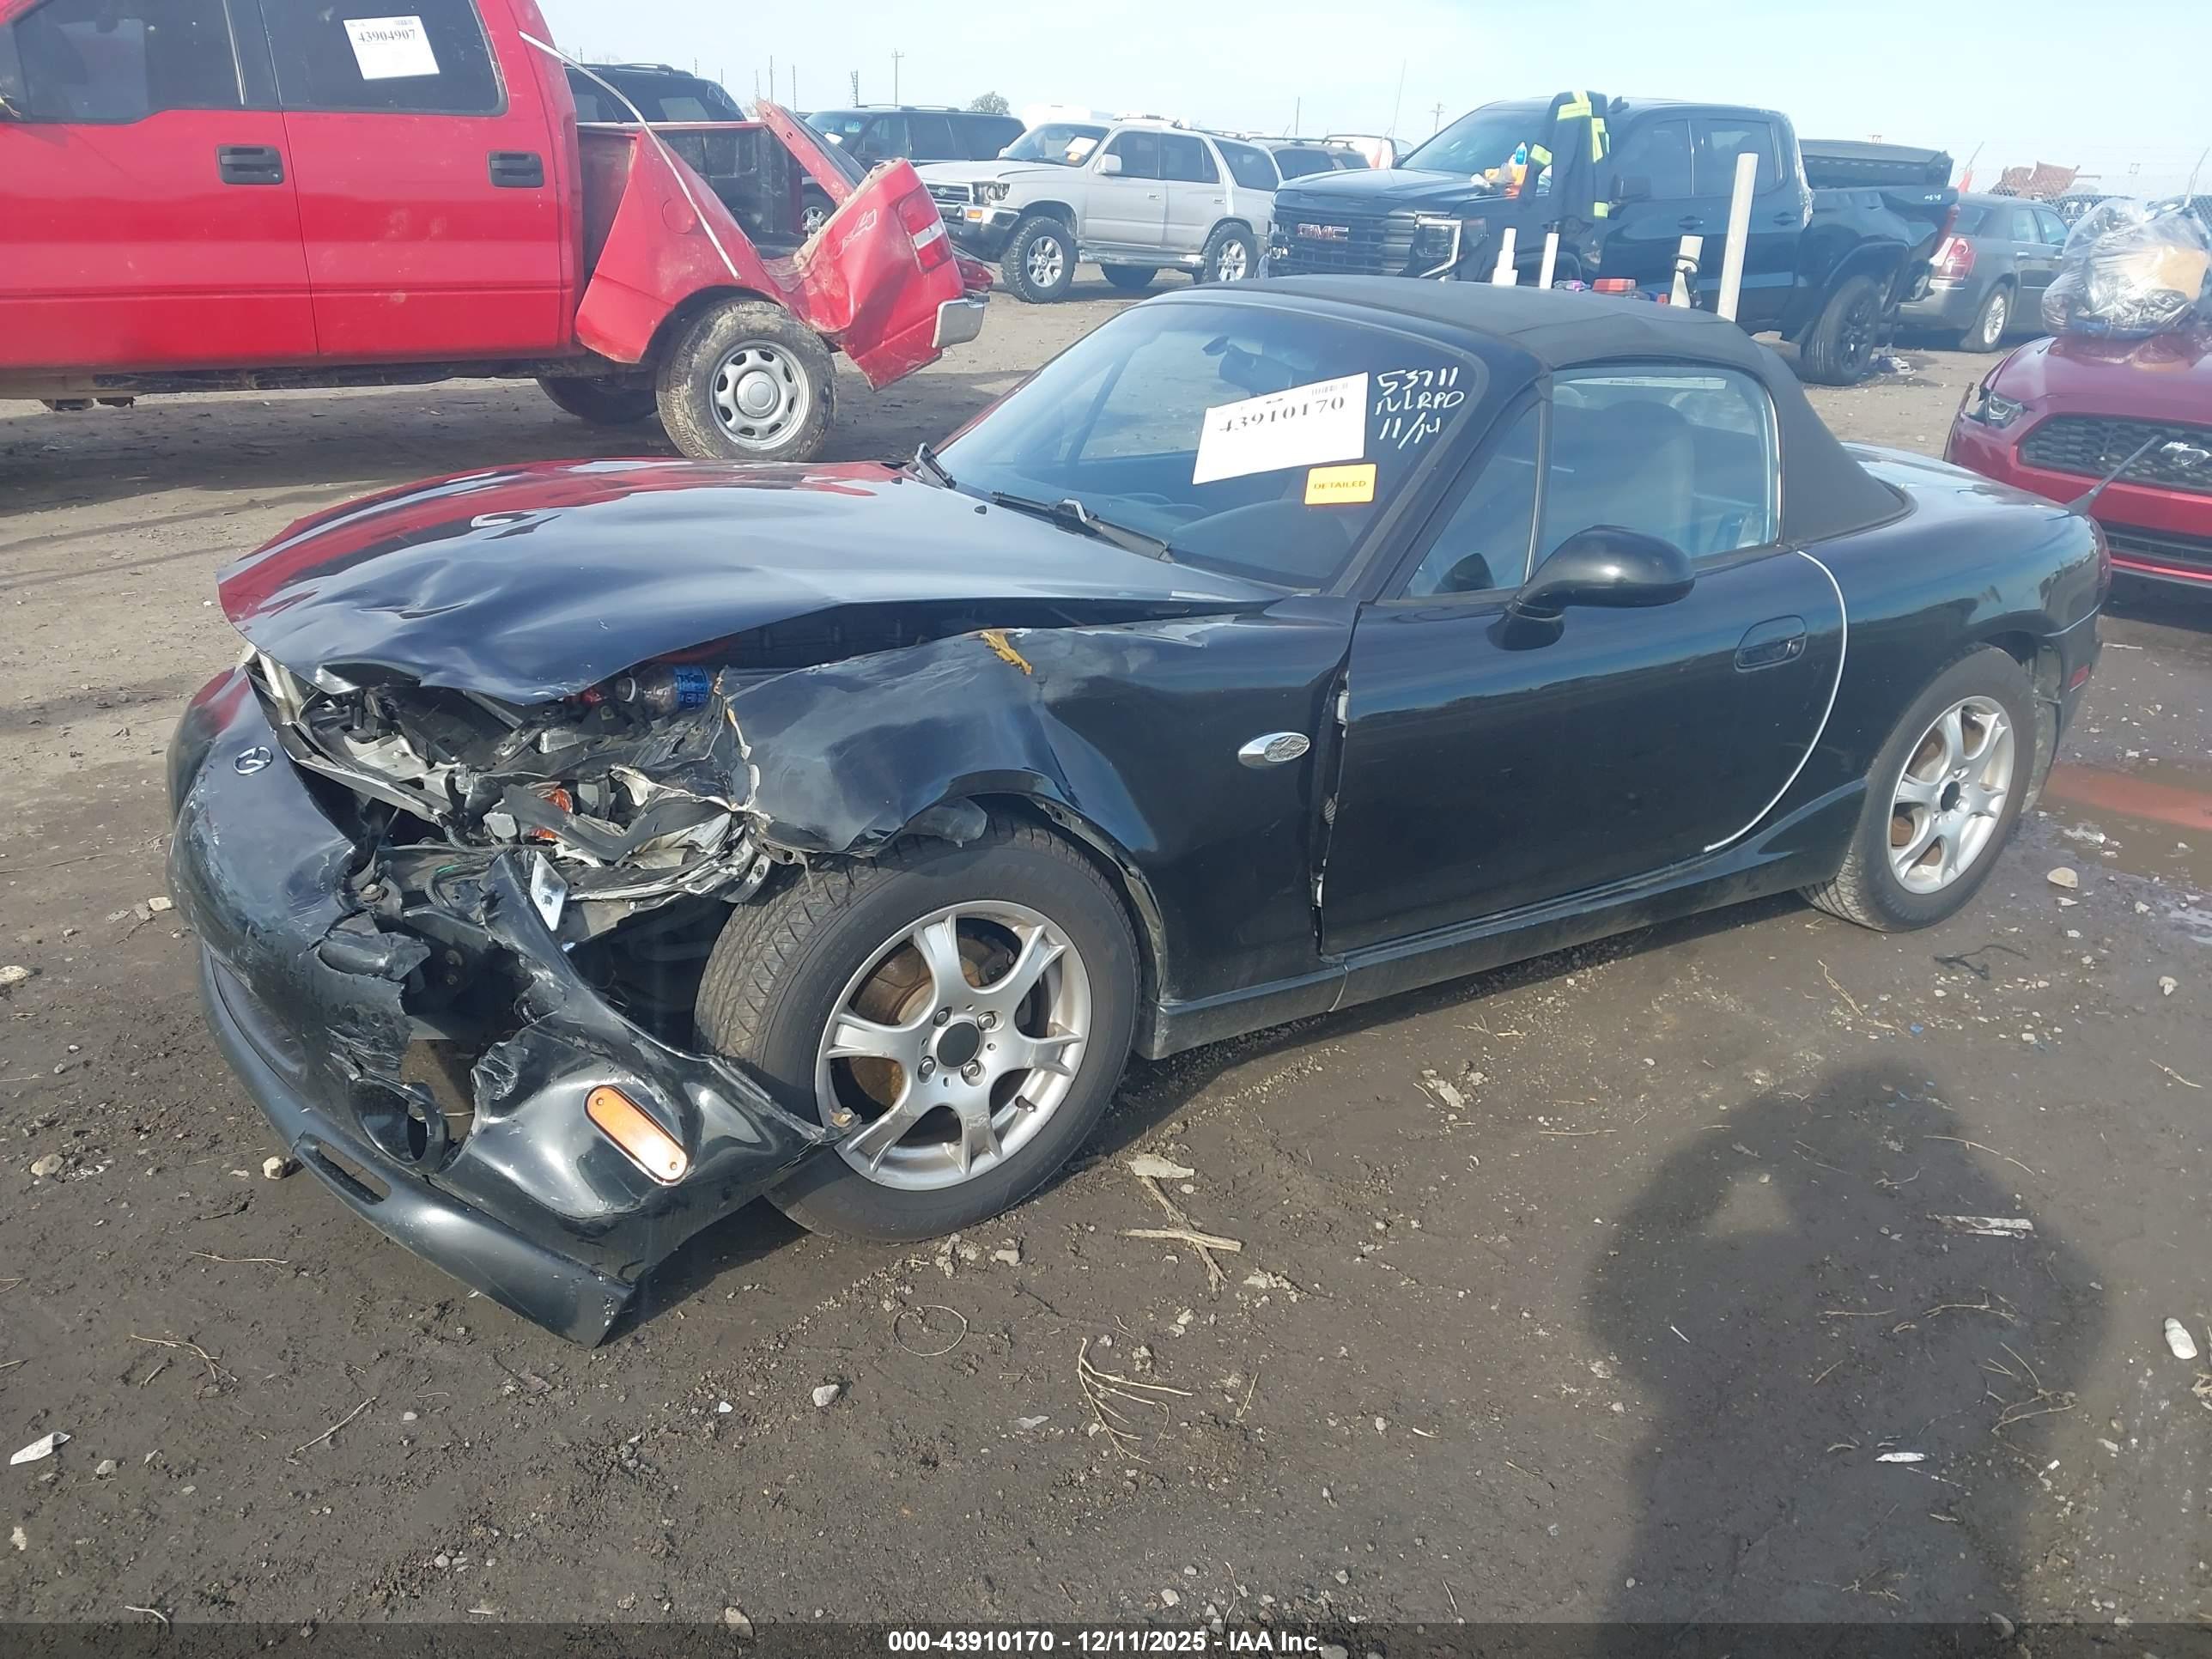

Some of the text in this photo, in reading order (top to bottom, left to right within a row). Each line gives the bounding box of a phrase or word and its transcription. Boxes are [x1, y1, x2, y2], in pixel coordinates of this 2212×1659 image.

[358, 28, 416, 43] 43904907
[1297, 222, 1349, 240] GMC
[1219, 397, 1345, 433] 43910170
[1313, 480, 1367, 489] DETAILED
